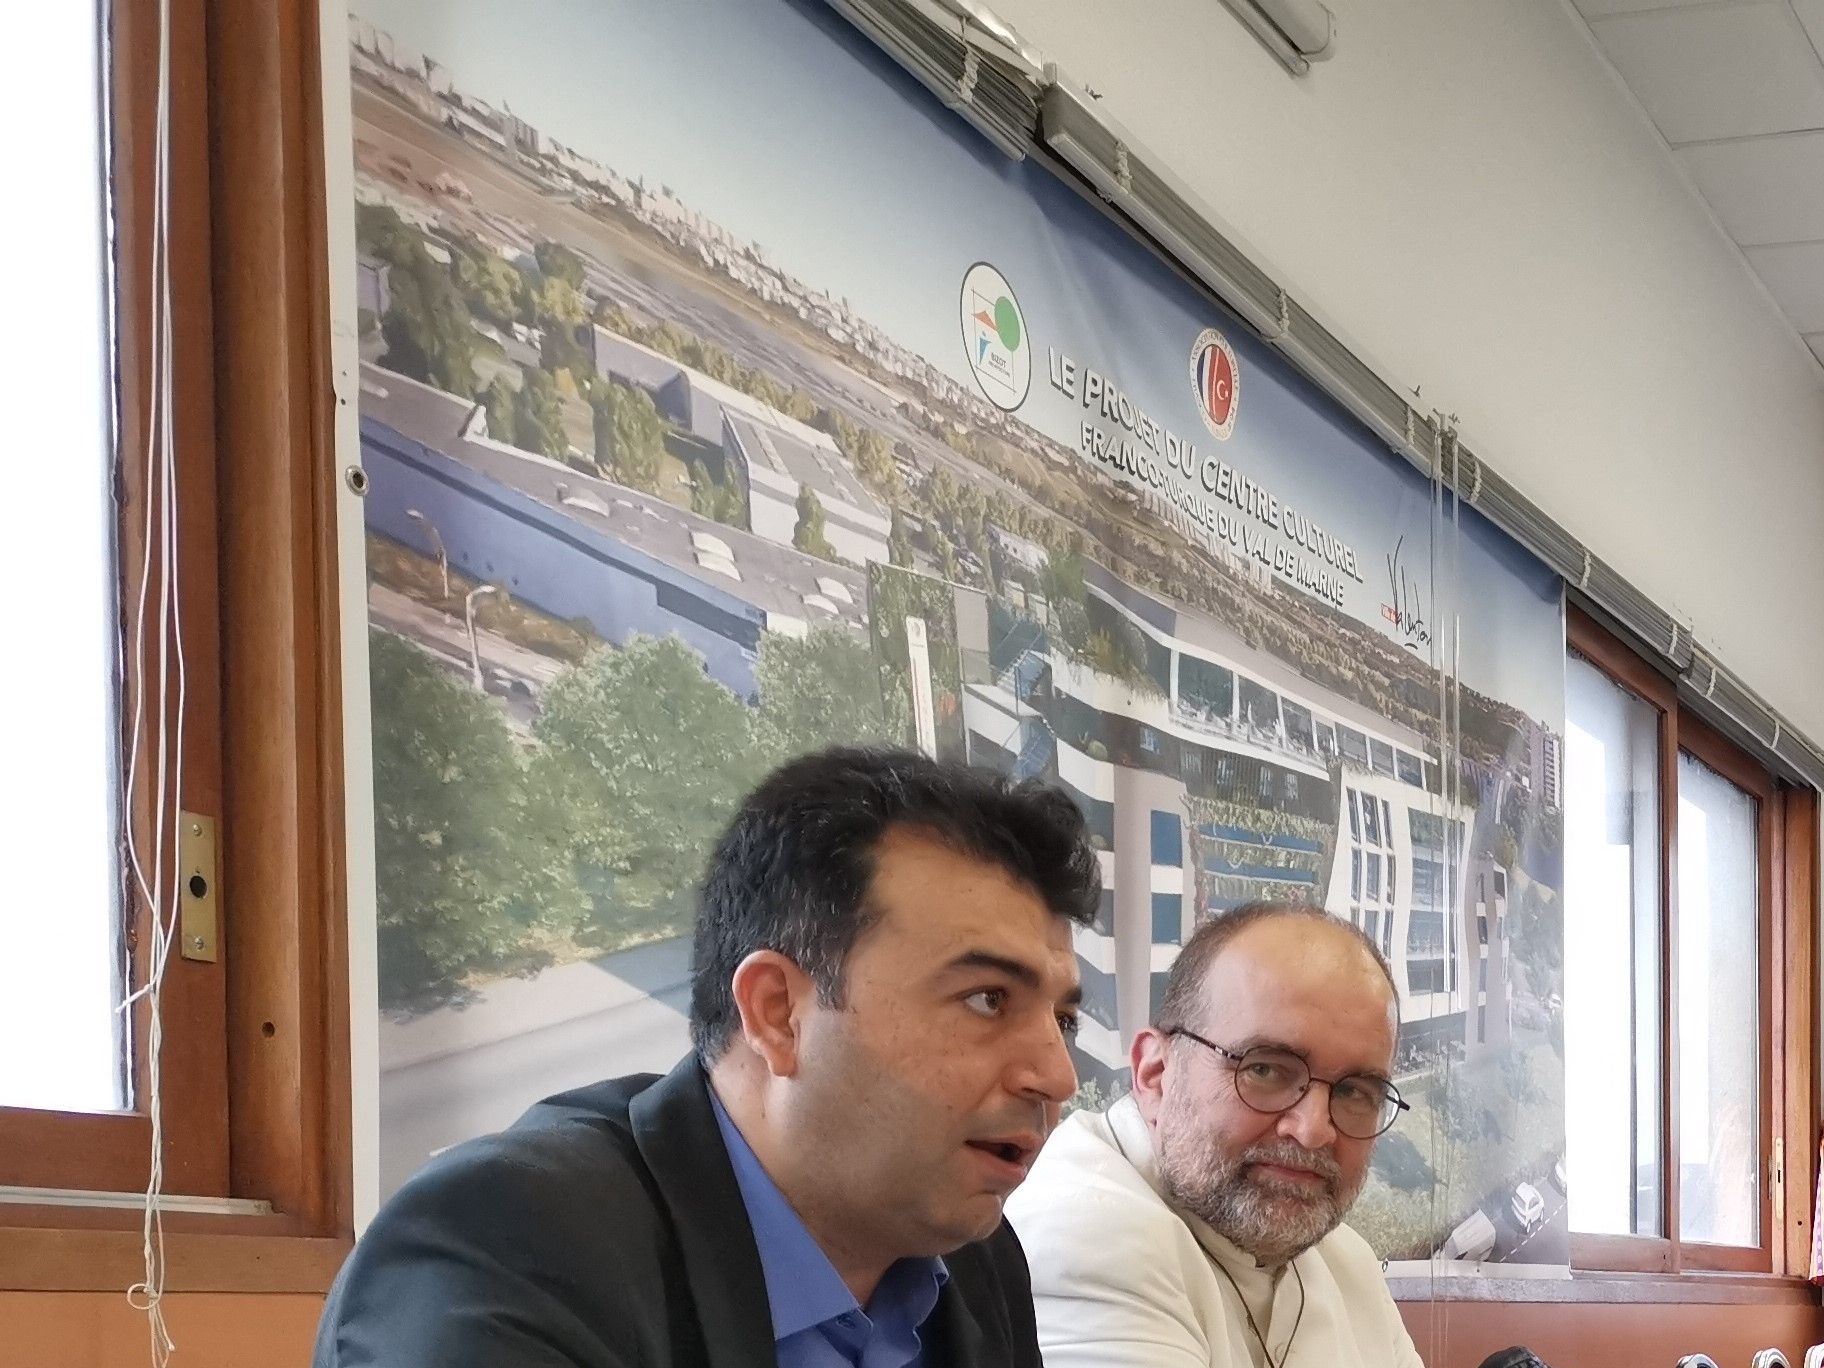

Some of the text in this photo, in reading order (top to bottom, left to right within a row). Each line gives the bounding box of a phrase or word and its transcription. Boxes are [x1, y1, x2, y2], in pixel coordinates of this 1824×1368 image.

[1049, 345, 1075, 400] LE
[1083, 368, 1160, 456] PROJET
[1164, 429, 1196, 480] DU
[1201, 456, 1279, 531] CENTRE
[1283, 504, 1364, 584] CULTUREL
[1217, 510, 1239, 547] DU
[1243, 523, 1271, 566] VAL
[1274, 544, 1295, 579] DE
[1297, 556, 1345, 607] MARNE
